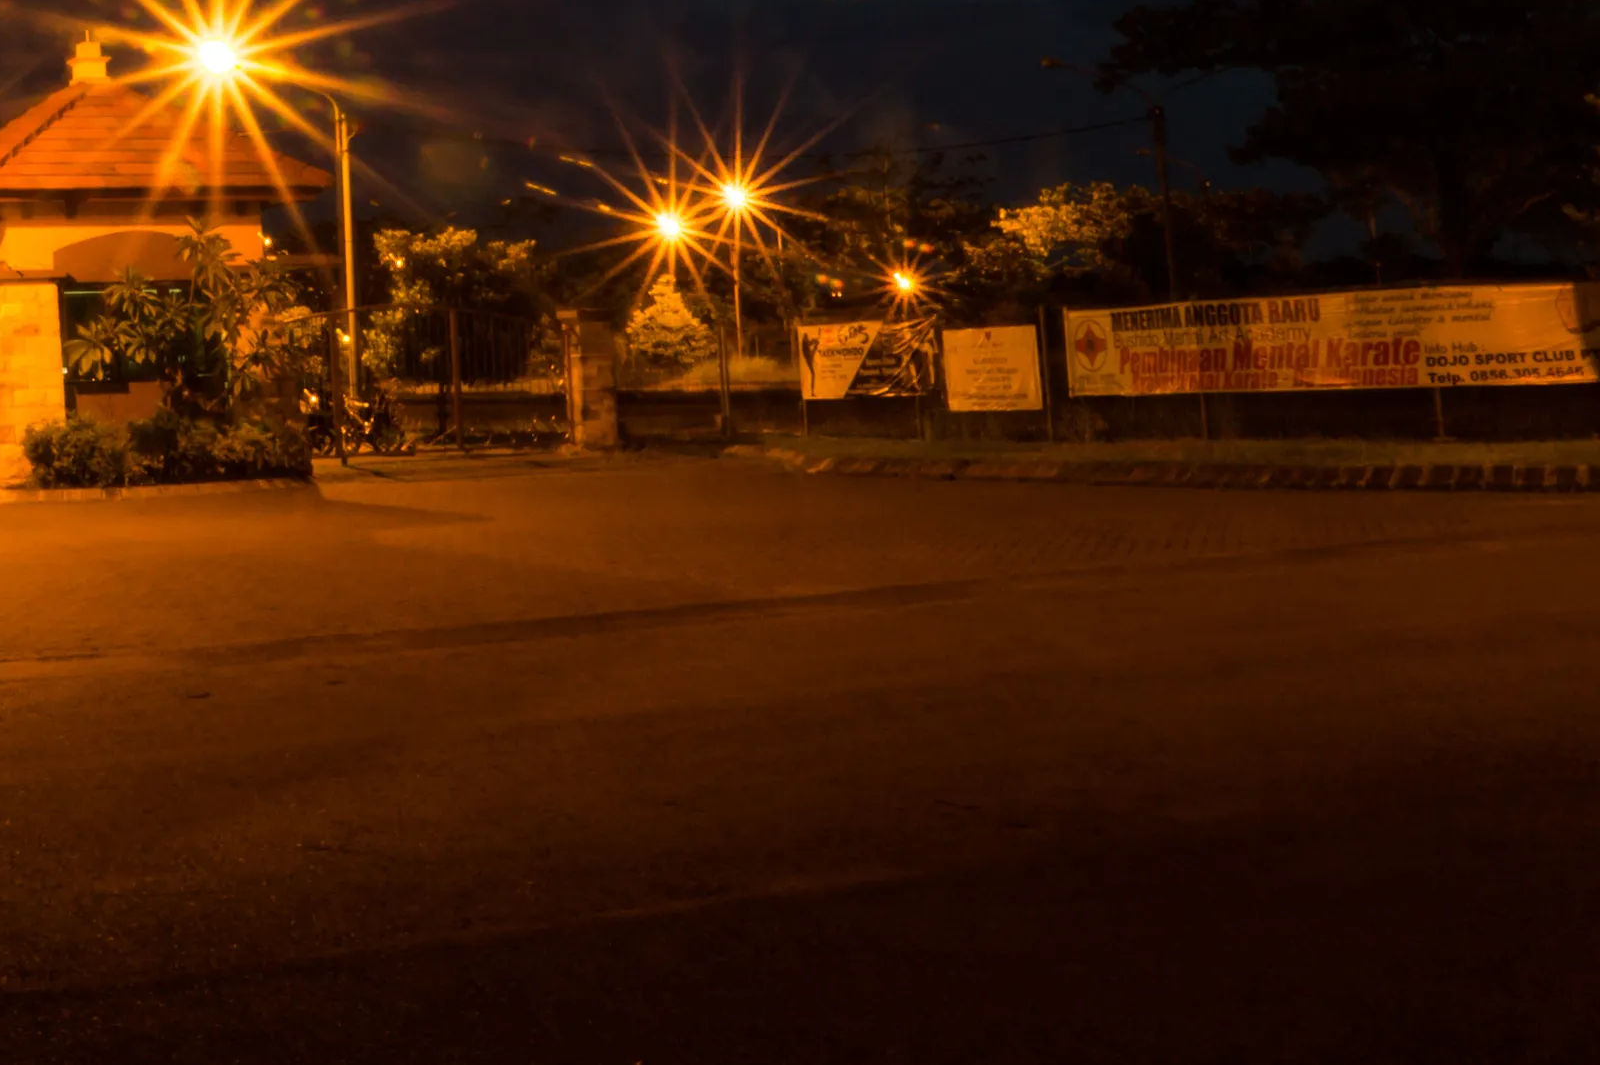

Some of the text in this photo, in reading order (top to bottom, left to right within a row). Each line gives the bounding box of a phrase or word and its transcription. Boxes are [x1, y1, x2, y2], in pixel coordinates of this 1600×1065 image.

[1111, 298, 1320, 332] MENERIMA ANGGOTA BARU
[1120, 337, 1420, 374] Pembinaan Mental Karate
[1426, 355, 1469, 367] DOJO
[1475, 352, 1526, 365] SPORT
[1532, 350, 1575, 363] CLUB
